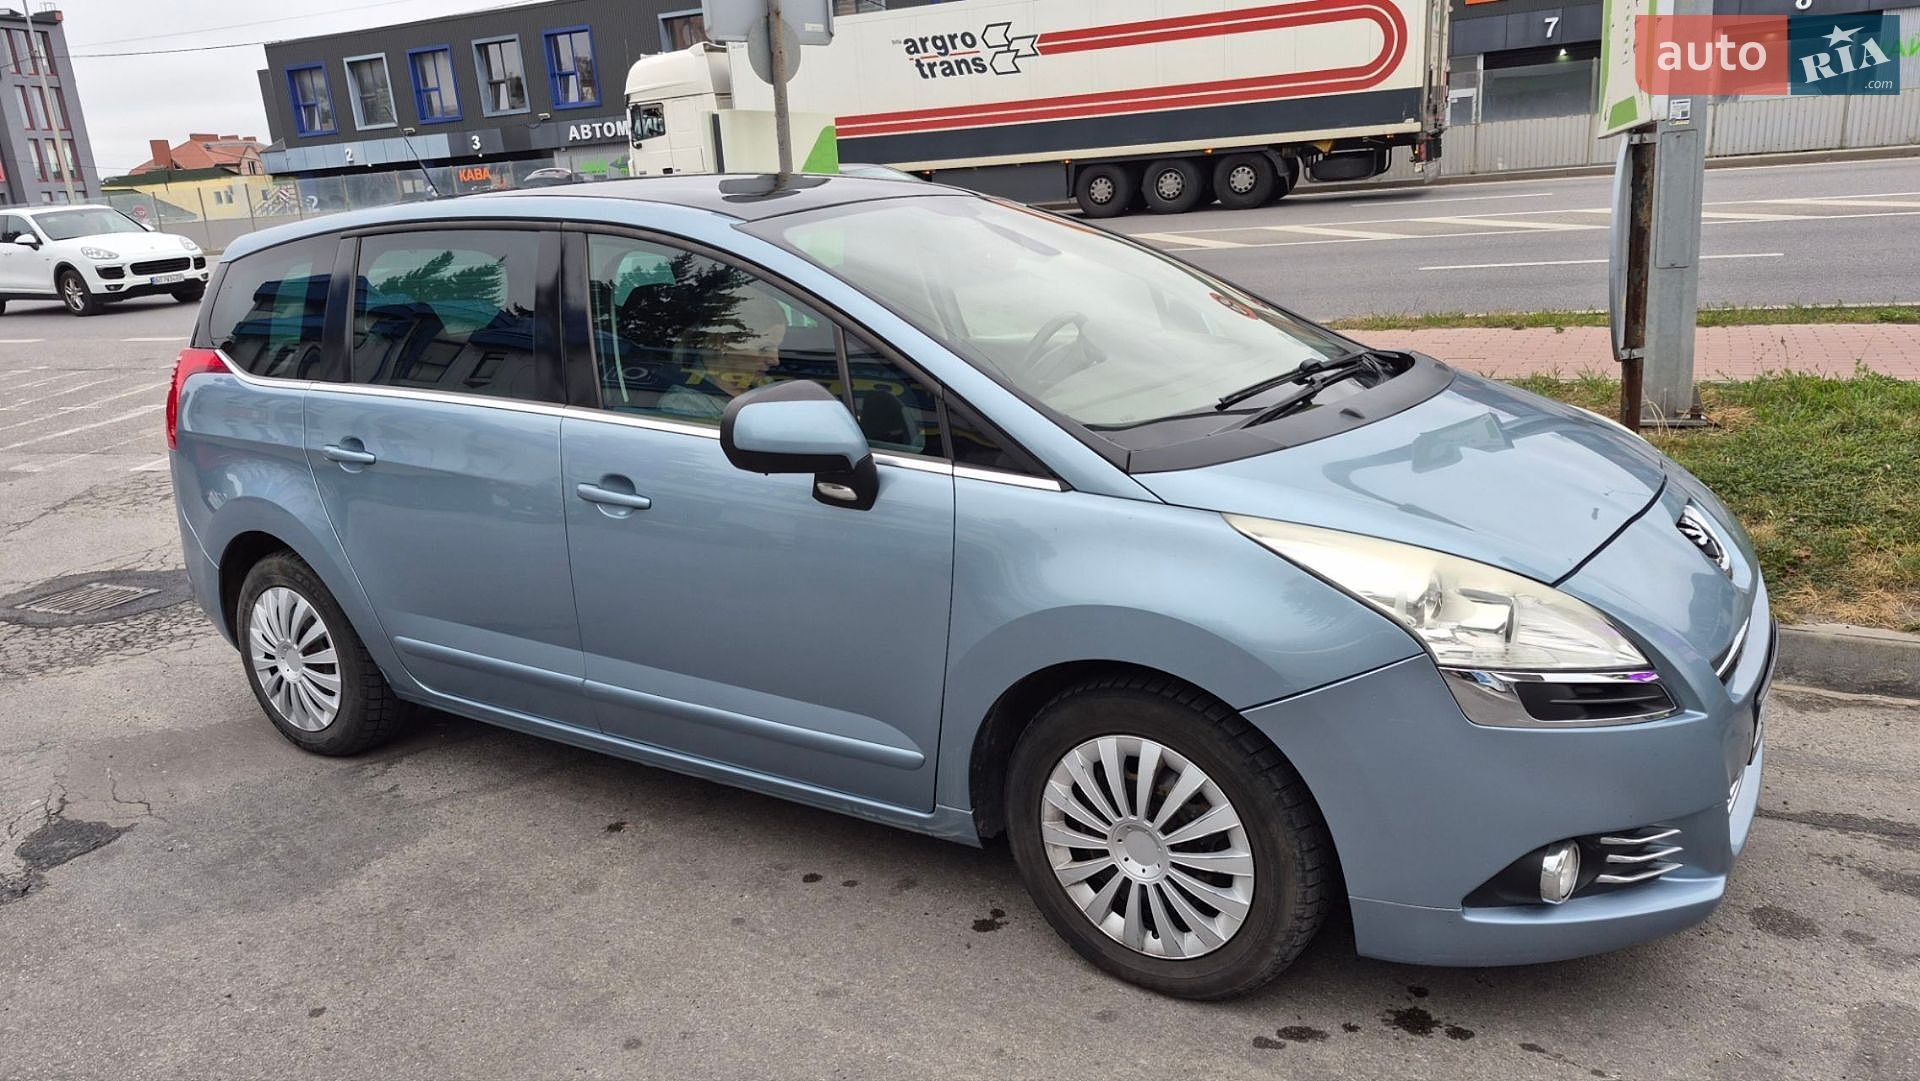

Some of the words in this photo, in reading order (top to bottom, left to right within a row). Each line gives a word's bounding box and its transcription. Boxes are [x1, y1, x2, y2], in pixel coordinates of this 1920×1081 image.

[1544, 16, 1559, 39] 7
[903, 31, 977, 57] argro
[914, 56, 988, 79] trans
[471, 135, 482, 150] 3
[344, 147, 355, 162] 2
[458, 164, 492, 182] КАВА
